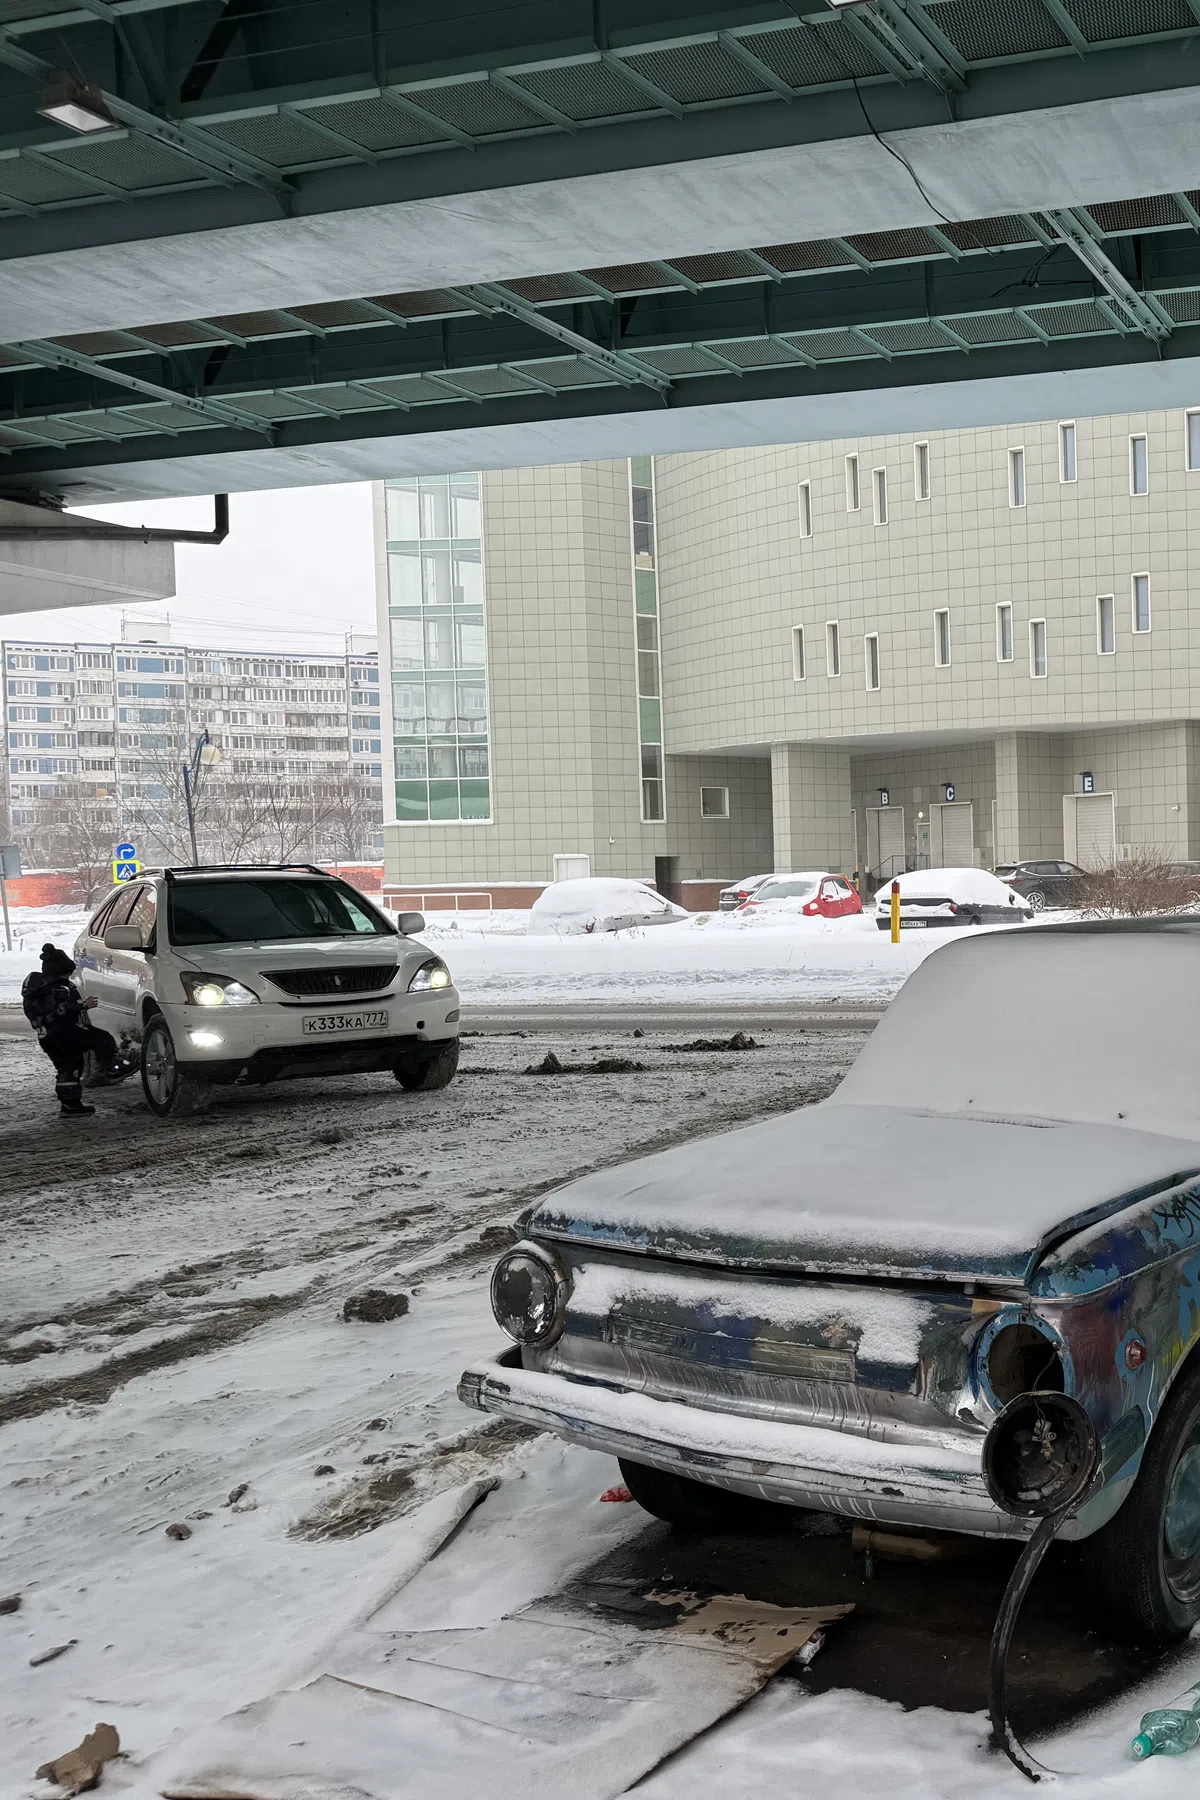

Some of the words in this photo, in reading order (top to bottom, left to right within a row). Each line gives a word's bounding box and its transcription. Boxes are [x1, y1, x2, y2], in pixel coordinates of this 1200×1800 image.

[1084, 776, 1092, 791] E
[881, 792, 889, 805] B
[946, 787, 954, 801] C
[308, 1016, 363, 1031] К333КА
